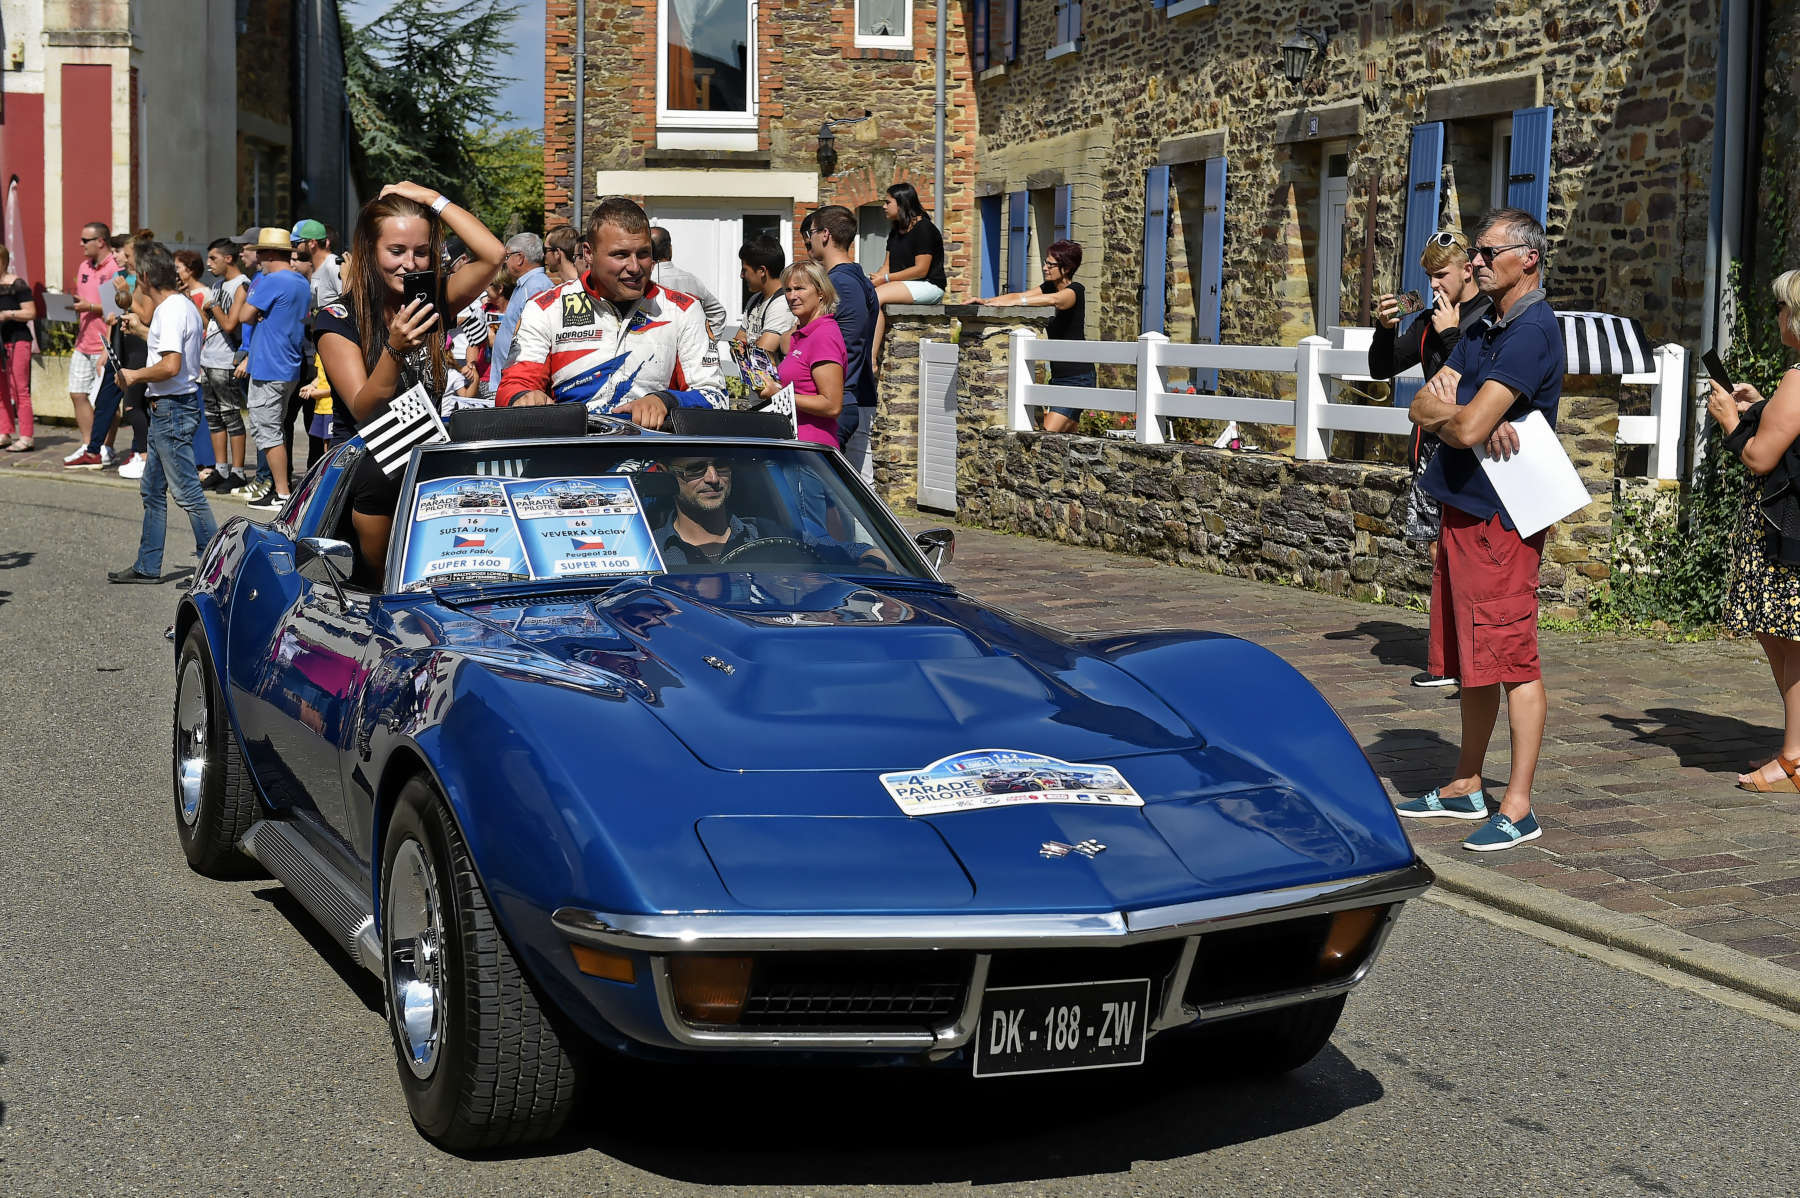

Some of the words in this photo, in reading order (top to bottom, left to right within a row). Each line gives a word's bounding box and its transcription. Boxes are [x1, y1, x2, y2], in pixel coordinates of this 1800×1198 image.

[420, 497, 460, 508] PARADE
[516, 498, 556, 507] PARADE
[425, 504, 460, 512] PILOTES
[524, 504, 558, 512] PILOTES
[439, 526, 469, 535] SUSTA
[472, 525, 500, 533] Josef
[541, 529, 587, 538] VEVERKA
[441, 549, 467, 557] Skoda
[431, 560, 467, 572] SUPER
[472, 559, 501, 567] 1600
[560, 560, 597, 570] SUPER
[602, 559, 630, 568] 1600
[896, 779, 978, 797] PARADE
[916, 788, 985, 802] PILOTES
[989, 1000, 1137, 1055] DK-188-ZW
